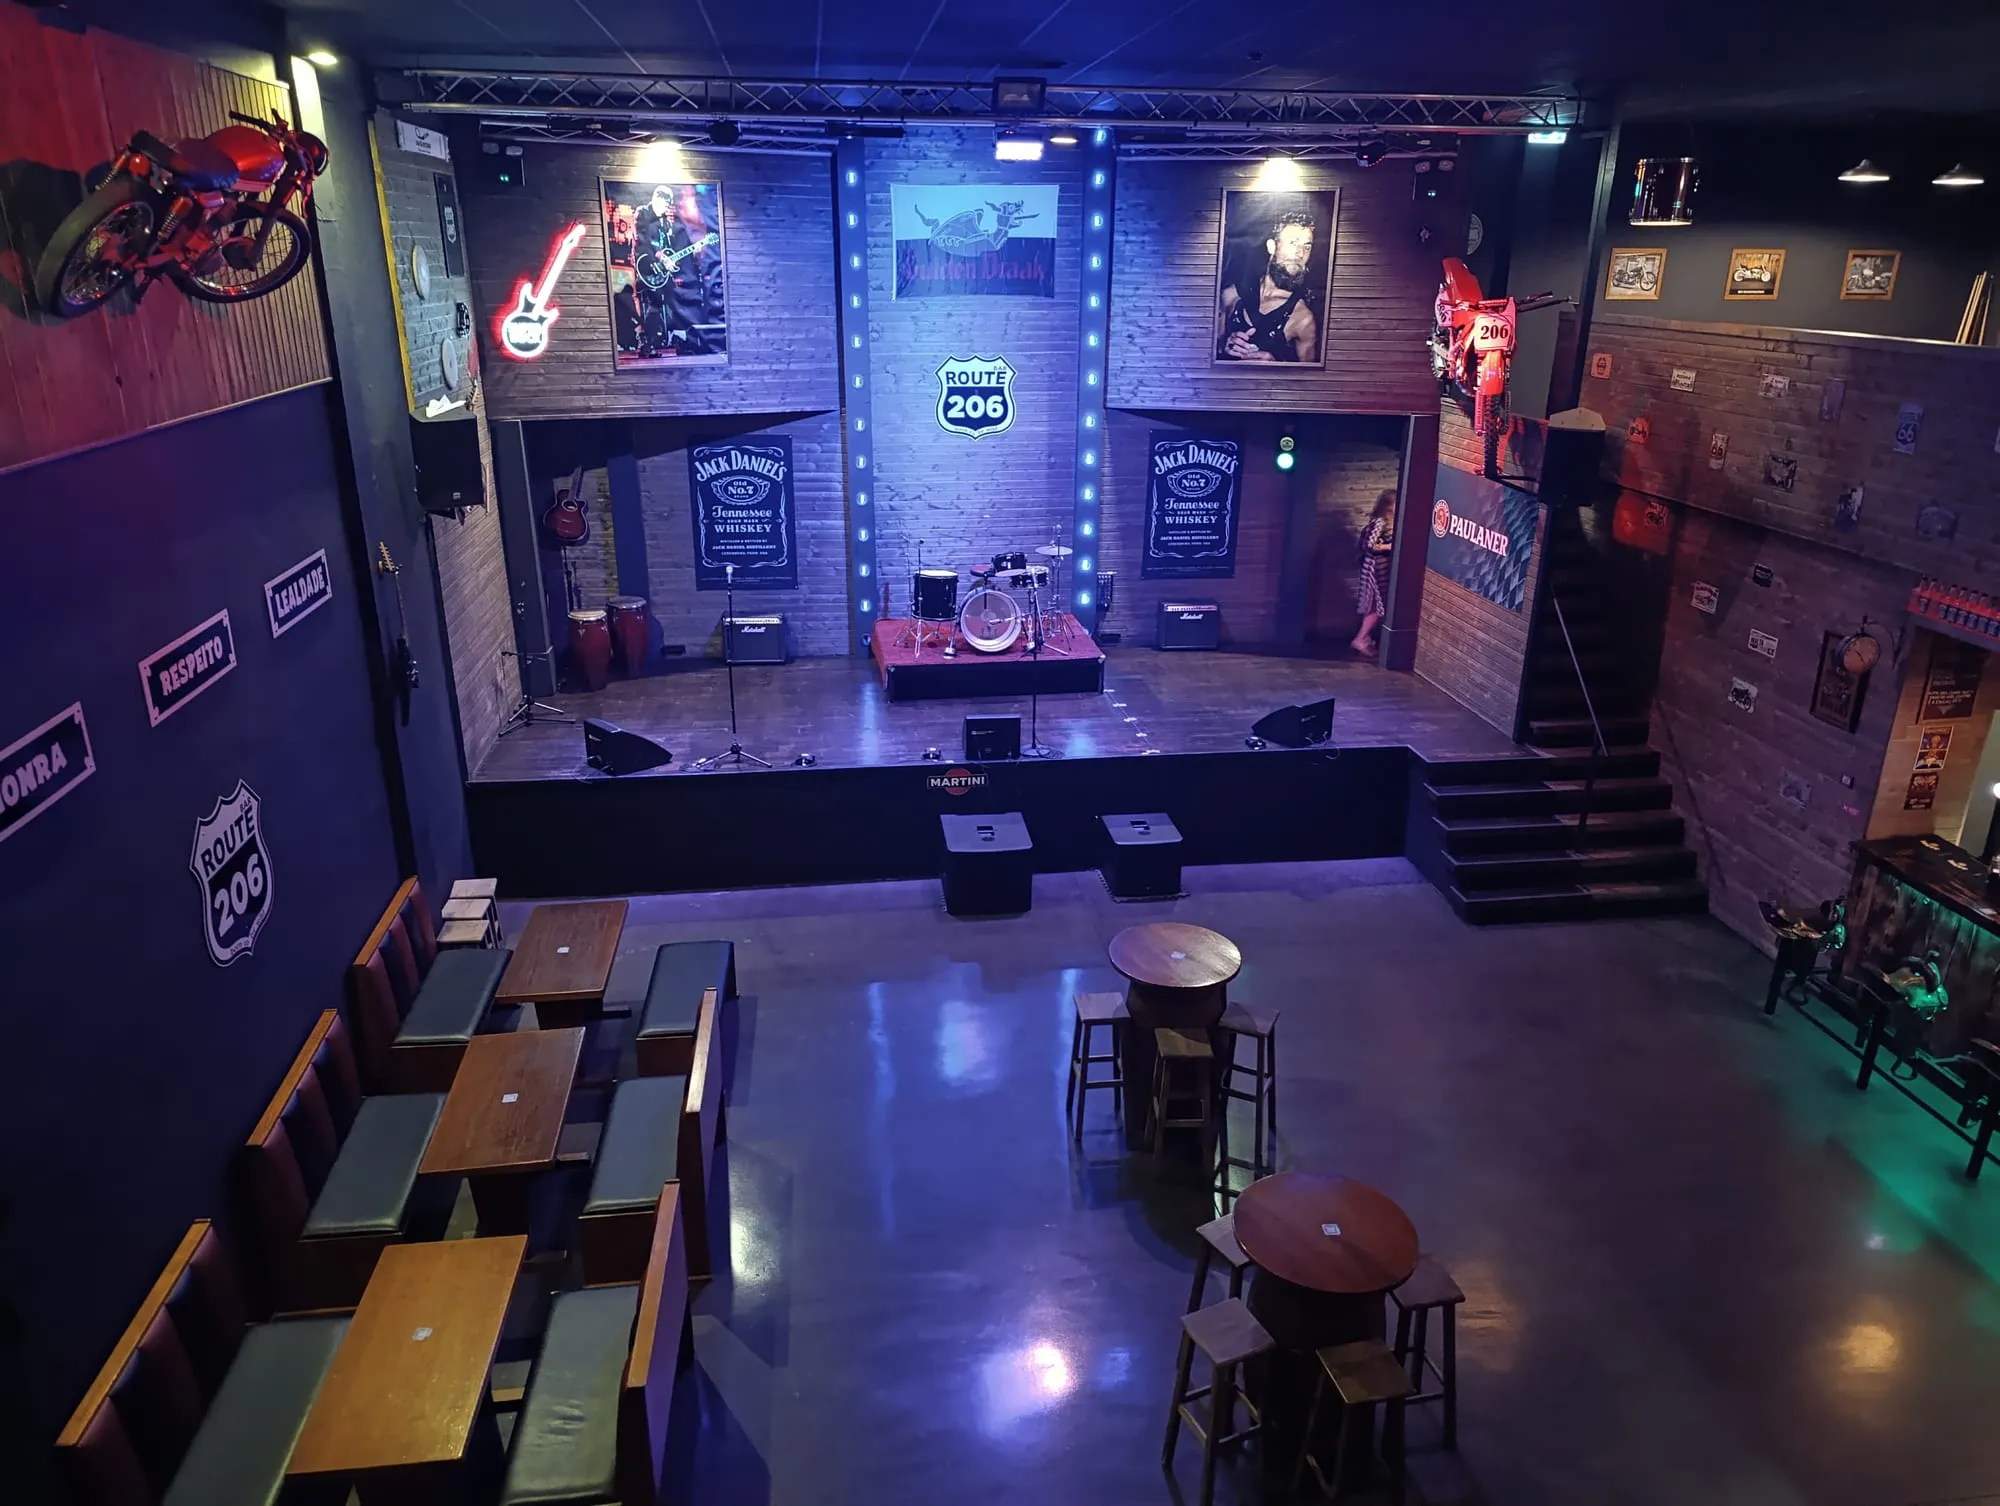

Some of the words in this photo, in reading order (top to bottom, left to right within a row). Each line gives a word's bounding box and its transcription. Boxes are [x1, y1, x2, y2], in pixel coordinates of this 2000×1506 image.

[1480, 324, 1509, 340] 206
[945, 371, 1007, 386] ROUTE
[947, 395, 1004, 419] 206
[694, 455, 732, 482] JACK
[1154, 449, 1188, 475] JACK
[712, 505, 772, 518] Tennessee
[1164, 498, 1220, 510] Tennessee
[713, 524, 772, 533] WHISKEY
[1164, 515, 1218, 524] WHISKEY
[1449, 514, 1509, 557] PAULANER
[275, 565, 325, 618] LEALDADE
[160, 635, 223, 696] RESPEITO
[930, 776, 985, 787] MARTINI
[201, 807, 255, 878] ROUTE
[214, 853, 263, 938] 206
